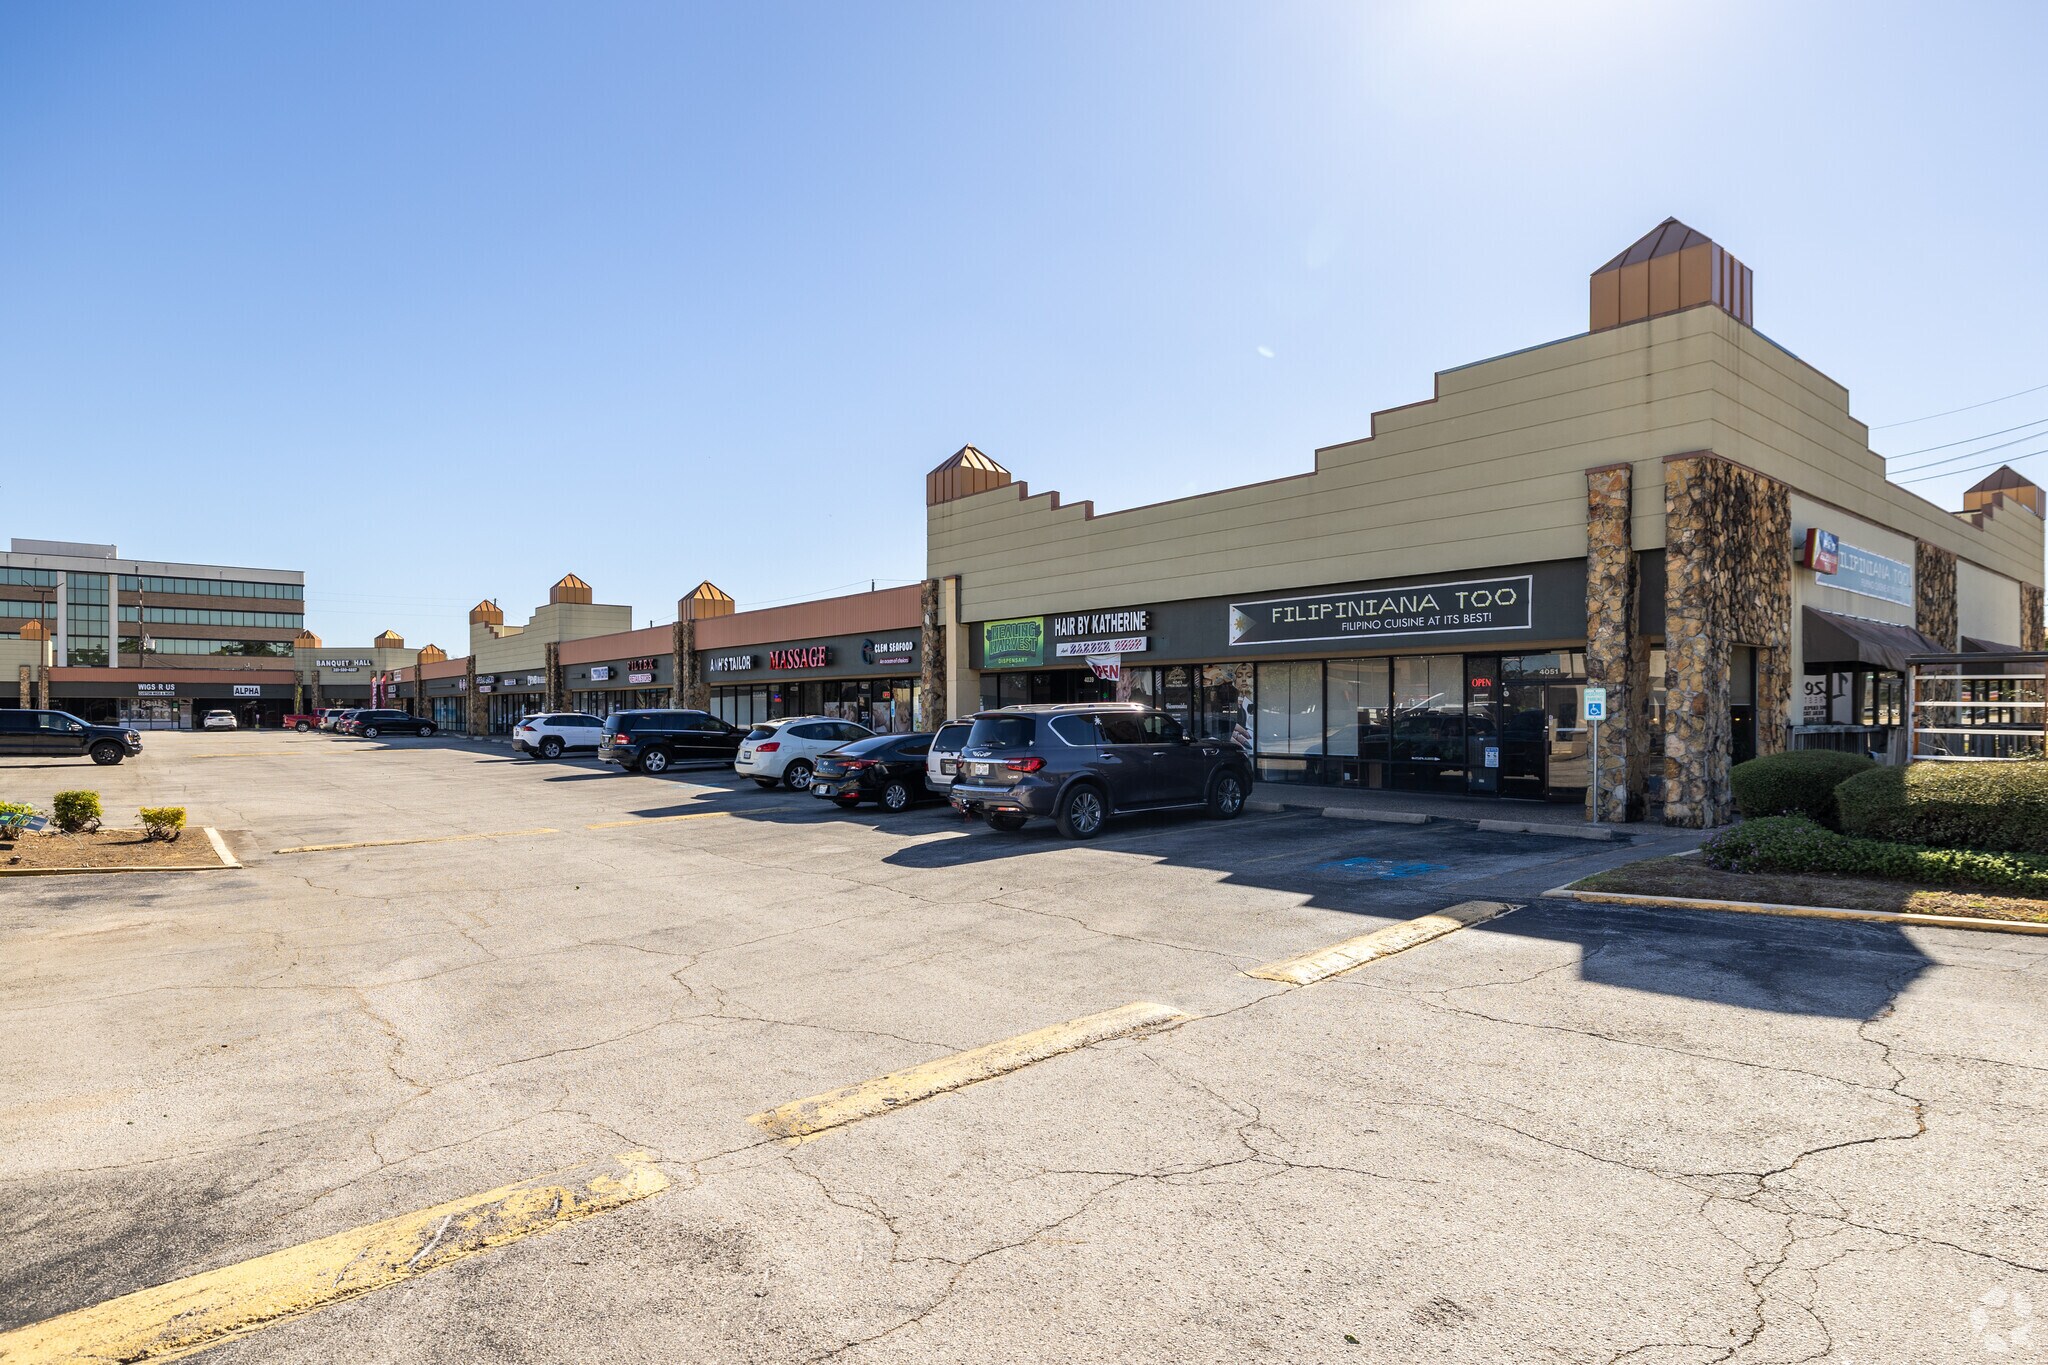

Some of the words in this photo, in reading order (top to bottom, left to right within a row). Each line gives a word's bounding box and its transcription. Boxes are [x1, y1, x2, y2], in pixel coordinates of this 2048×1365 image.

[1840, 551, 1890, 580] ILIPINIANA
[1272, 593, 1440, 623] FILIPINIANA
[1455, 588, 1517, 609] TOO
[1054, 617, 1076, 636] HAIR
[1077, 615, 1090, 635] BY
[1091, 610, 1147, 634] KATHERINE
[1341, 620, 1381, 631] FILIPINO
[1384, 617, 1425, 629] CUISINE
[1427, 616, 1440, 626] AT
[1444, 615, 1460, 625] ITS
[1463, 612, 1492, 623] BEST!
[991, 622, 1036, 640] HEALING
[889, 641, 913, 652] SEAFOOD
[990, 637, 1037, 655] HARVEST
[728, 655, 751, 671] TAILOR
[769, 646, 826, 670] MASSAGE
[234, 687, 259, 695] ALPHA
[1472, 678, 1492, 687] OPEN
